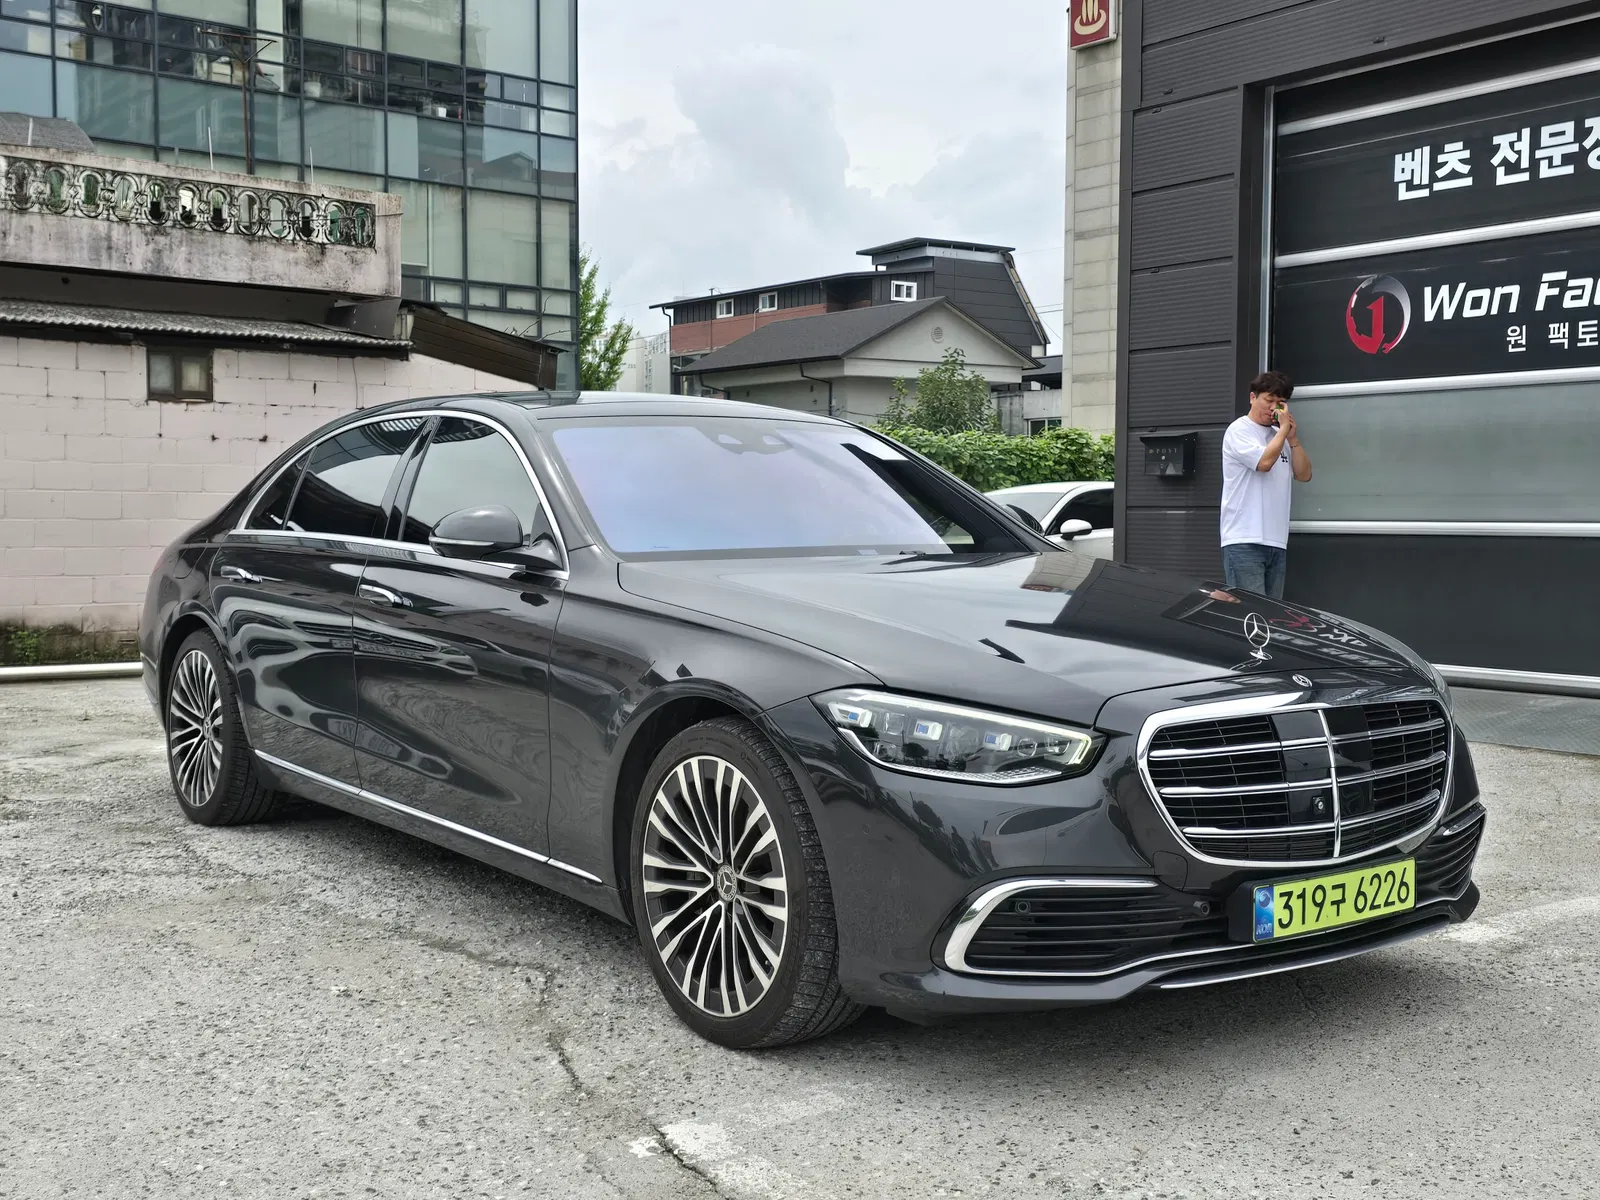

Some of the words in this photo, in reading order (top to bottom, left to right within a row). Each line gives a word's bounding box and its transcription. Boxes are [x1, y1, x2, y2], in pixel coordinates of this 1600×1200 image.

[1394, 141, 1473, 201] 벤츠
[1423, 282, 1521, 322] Won
[1535, 270, 1600, 311] Fa
[1506, 324, 1527, 353] 원
[1277, 882, 1347, 930] 319구
[1353, 867, 1410, 914] 6226
